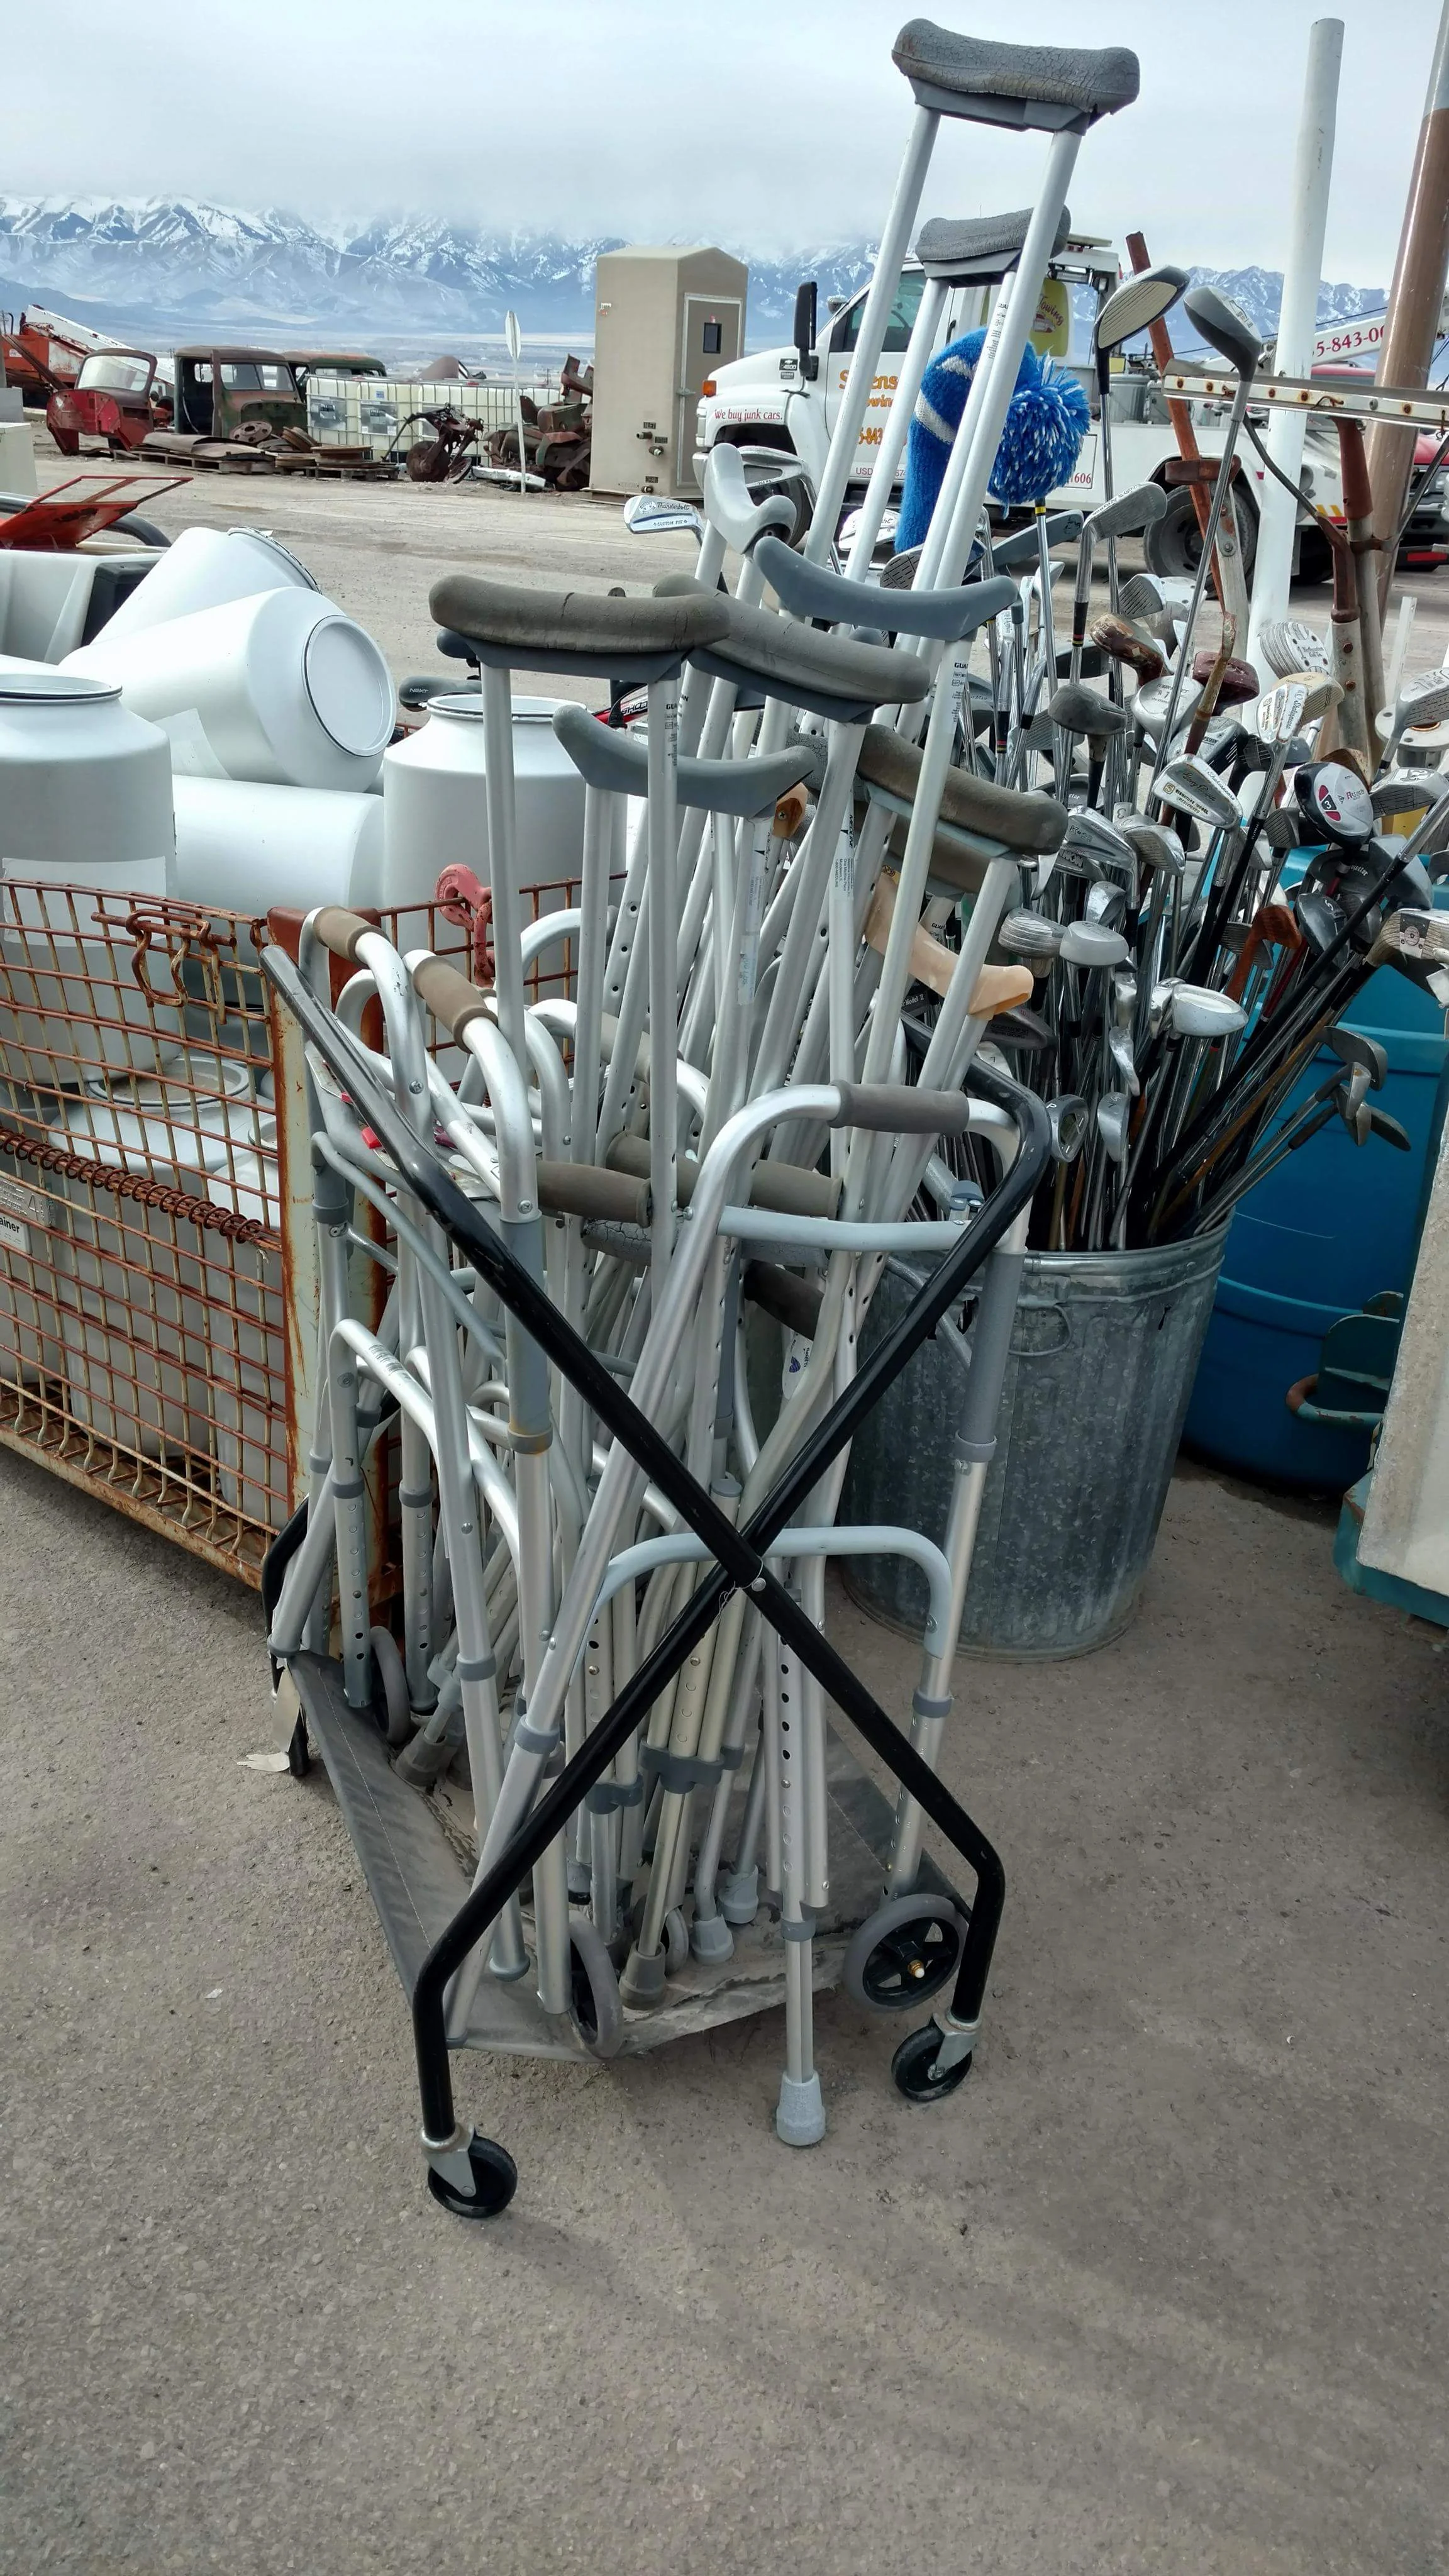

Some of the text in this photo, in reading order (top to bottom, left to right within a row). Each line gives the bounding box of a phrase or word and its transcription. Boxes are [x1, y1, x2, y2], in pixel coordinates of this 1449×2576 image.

[866, 394, 894, 408] owin
[714, 409, 783, 422] We buy junk cars.
[855, 467, 874, 475] USD
[657, 502, 689, 510] Thunderbolt
[1207, 771, 1236, 801] Shakespeare
[1324, 801, 1331, 809] 3
[0, 1216, 19, 1233] ainer
